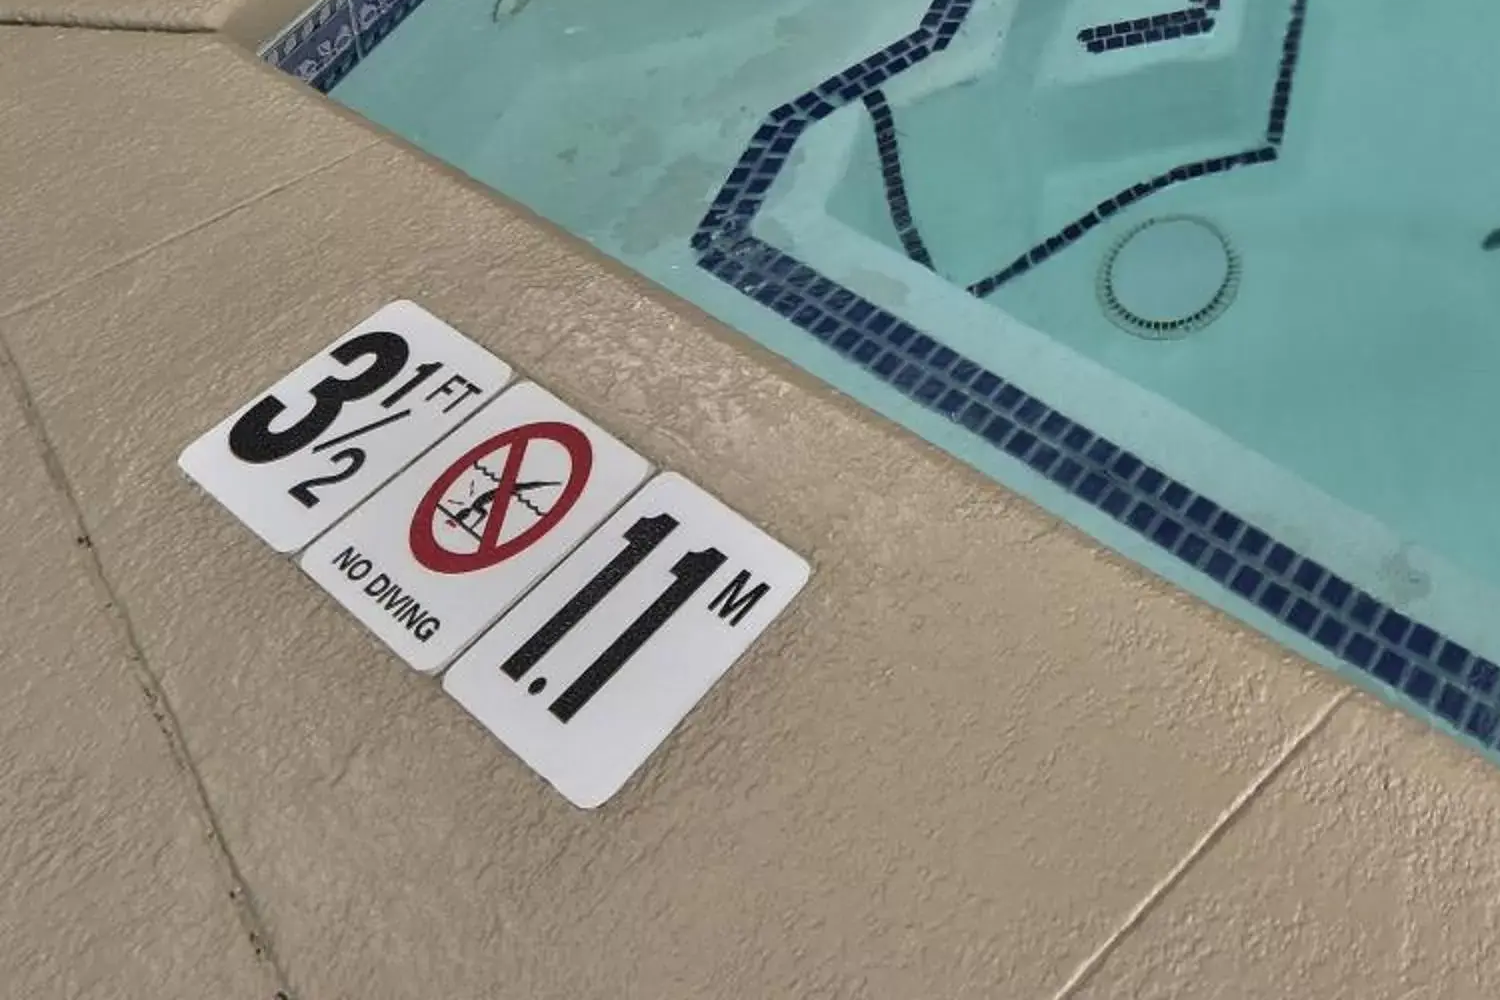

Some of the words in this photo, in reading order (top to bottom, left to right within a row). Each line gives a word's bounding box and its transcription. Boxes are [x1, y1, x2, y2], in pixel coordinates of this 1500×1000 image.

[228, 331, 410, 465] 3
[425, 375, 483, 414] FT
[331, 545, 373, 583] NO
[364, 573, 441, 644] DIVING
[499, 513, 729, 724] 1.1
[707, 569, 771, 627] M
